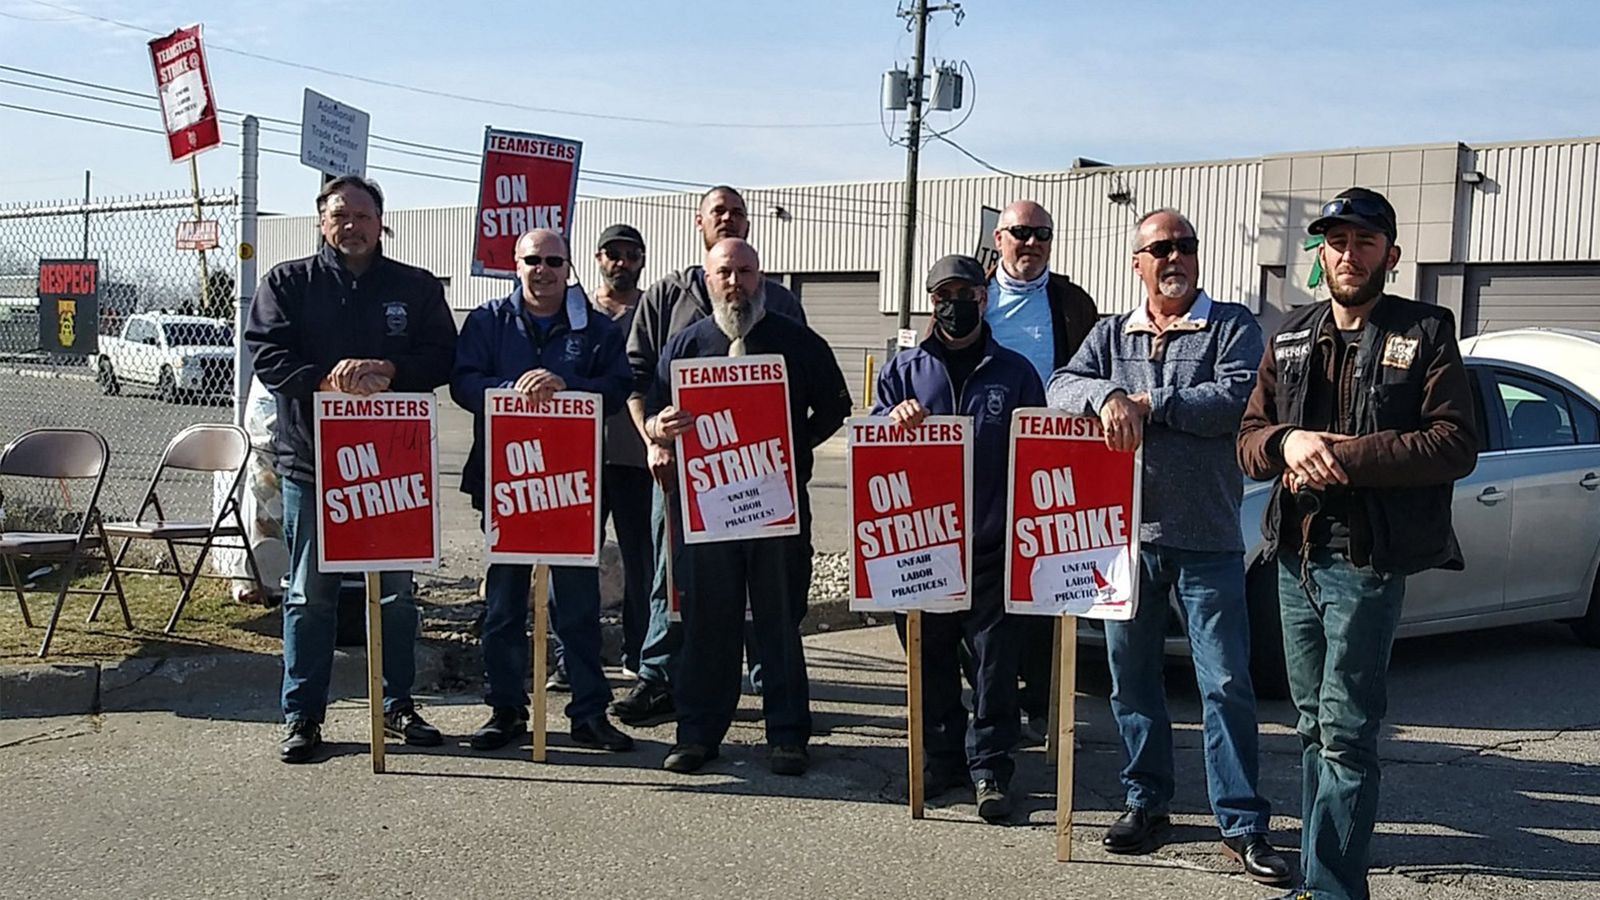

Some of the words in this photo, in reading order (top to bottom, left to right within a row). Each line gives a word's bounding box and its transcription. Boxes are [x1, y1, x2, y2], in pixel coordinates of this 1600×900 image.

[160, 56, 189, 82] STRIKE
[318, 100, 356, 123] Additional
[320, 113, 351, 136] Redford
[311, 123, 331, 141] Trade
[333, 133, 359, 151] Center
[489, 134, 576, 160] TEAMSTERS
[307, 150, 345, 174] Southest
[319, 140, 348, 164] Parking
[495, 174, 528, 204] ON
[482, 204, 564, 238] STRIKE
[39, 263, 97, 295] RESPECT
[678, 362, 784, 385] TEAMSTERS
[322, 399, 430, 417] TEAMSTERS
[492, 396, 595, 415] TEAMSTERS
[695, 409, 739, 450] ON
[853, 423, 963, 443] TEAMSTERS
[337, 442, 381, 482] ON
[505, 438, 546, 477] ON
[687, 437, 789, 493] STRIKE
[325, 473, 430, 525] STRIKE
[494, 470, 593, 517] STRIKE
[727, 487, 760, 502] UNFAIR
[867, 470, 913, 513] ON
[1030, 466, 1076, 511] ON
[725, 508, 776, 529] PRACTICES!
[732, 500, 762, 514] LABOR
[857, 502, 963, 559] STRIKE
[1015, 505, 1128, 559] STRIKE
[896, 553, 932, 569] UNFAIR
[891, 577, 948, 599] PRACTICES!
[900, 567, 933, 583] LABOR
